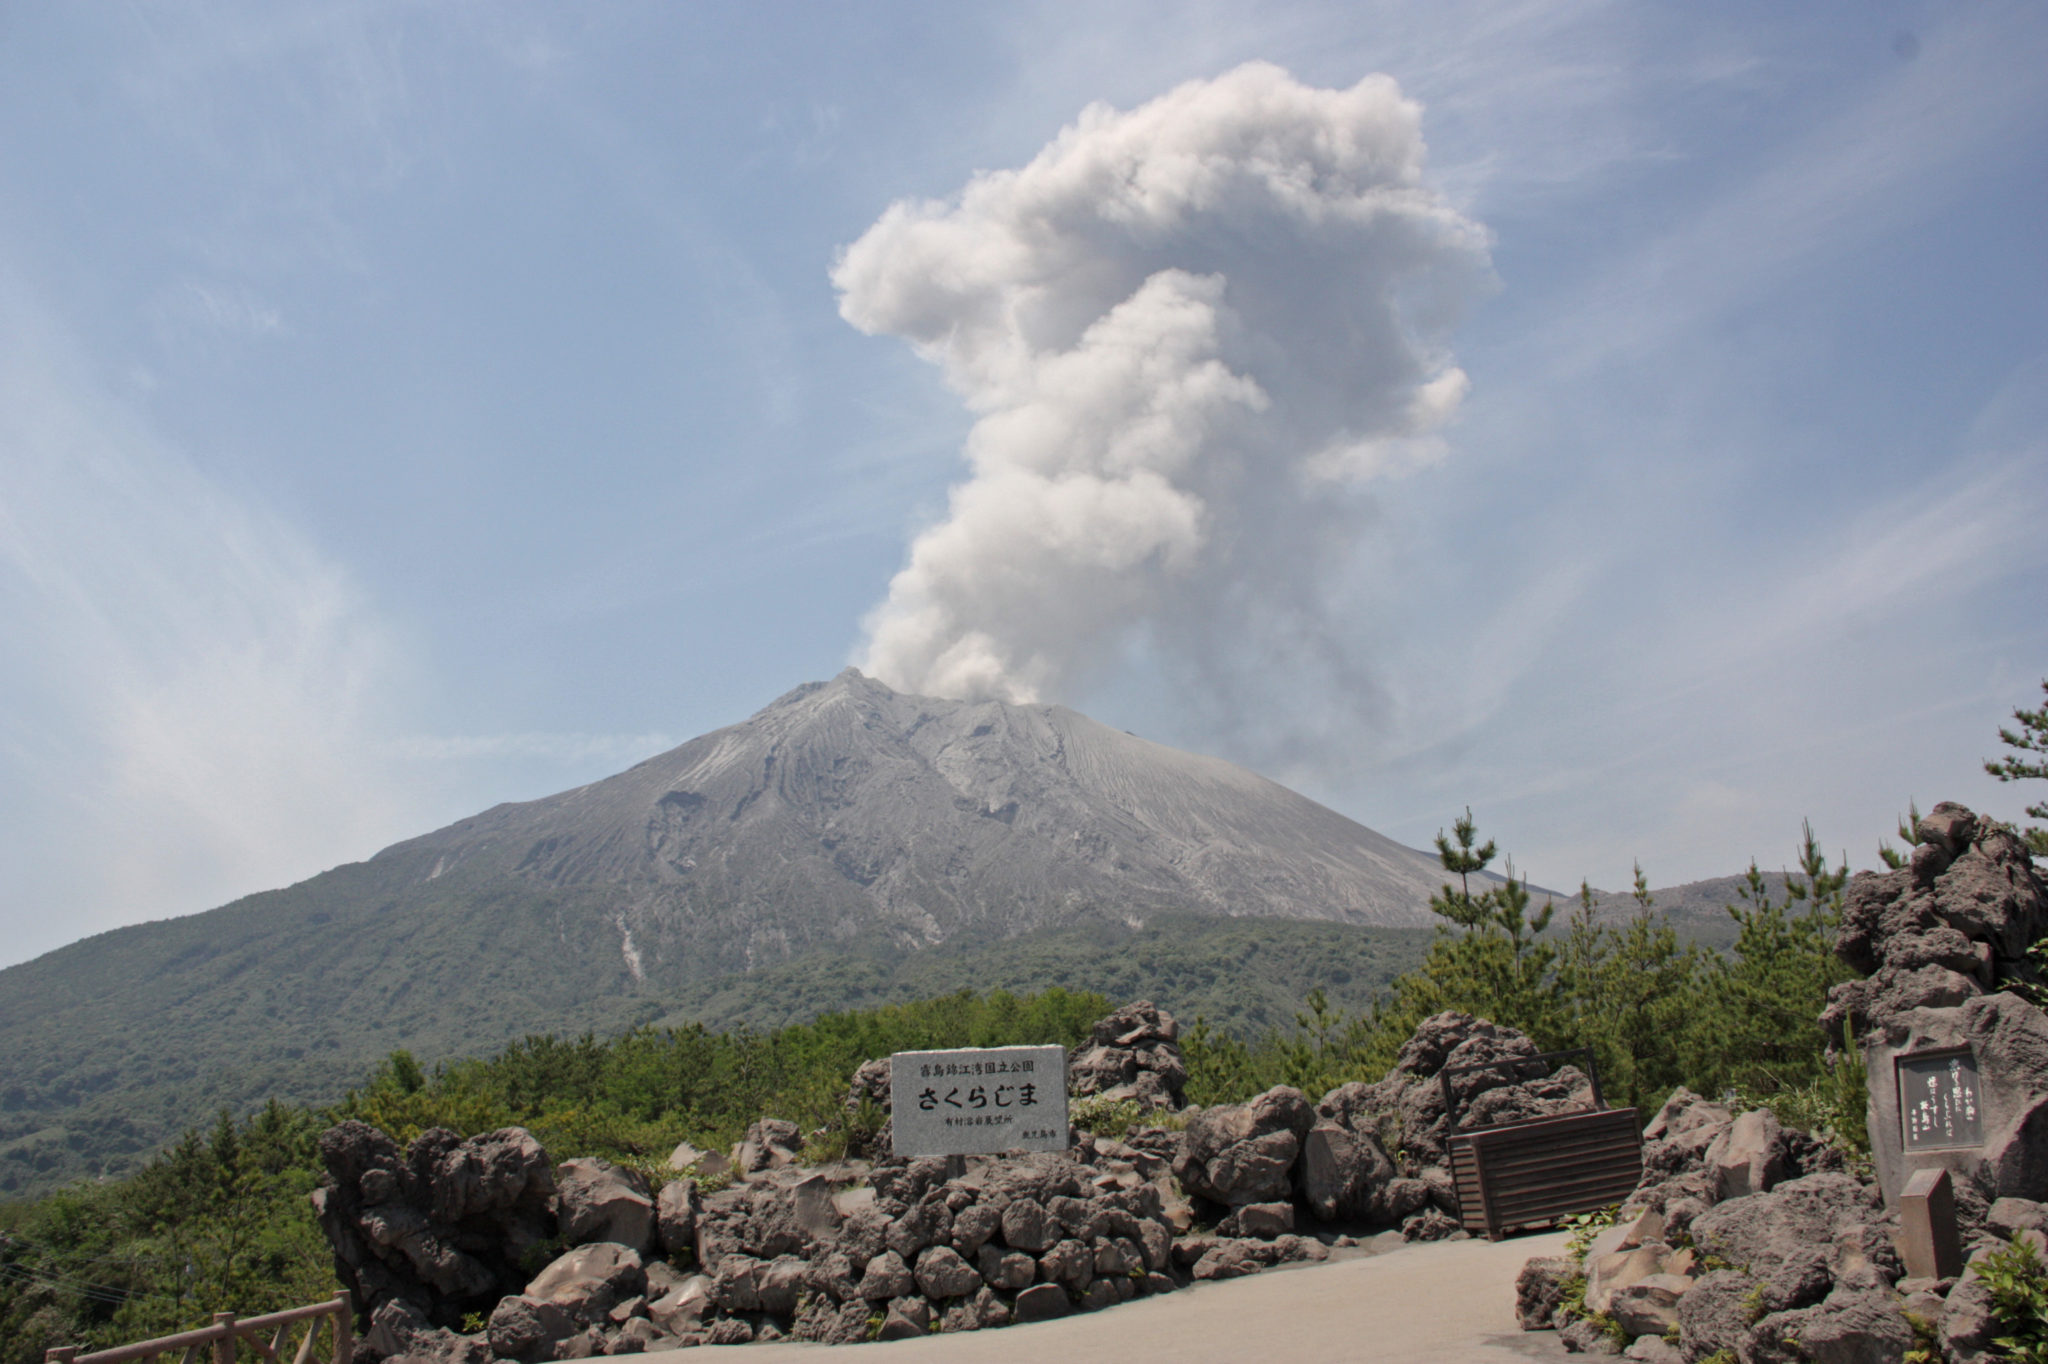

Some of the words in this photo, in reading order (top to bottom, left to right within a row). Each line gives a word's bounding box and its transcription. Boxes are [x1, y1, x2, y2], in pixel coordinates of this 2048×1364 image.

[918, 1083, 1038, 1110] さくらじま
